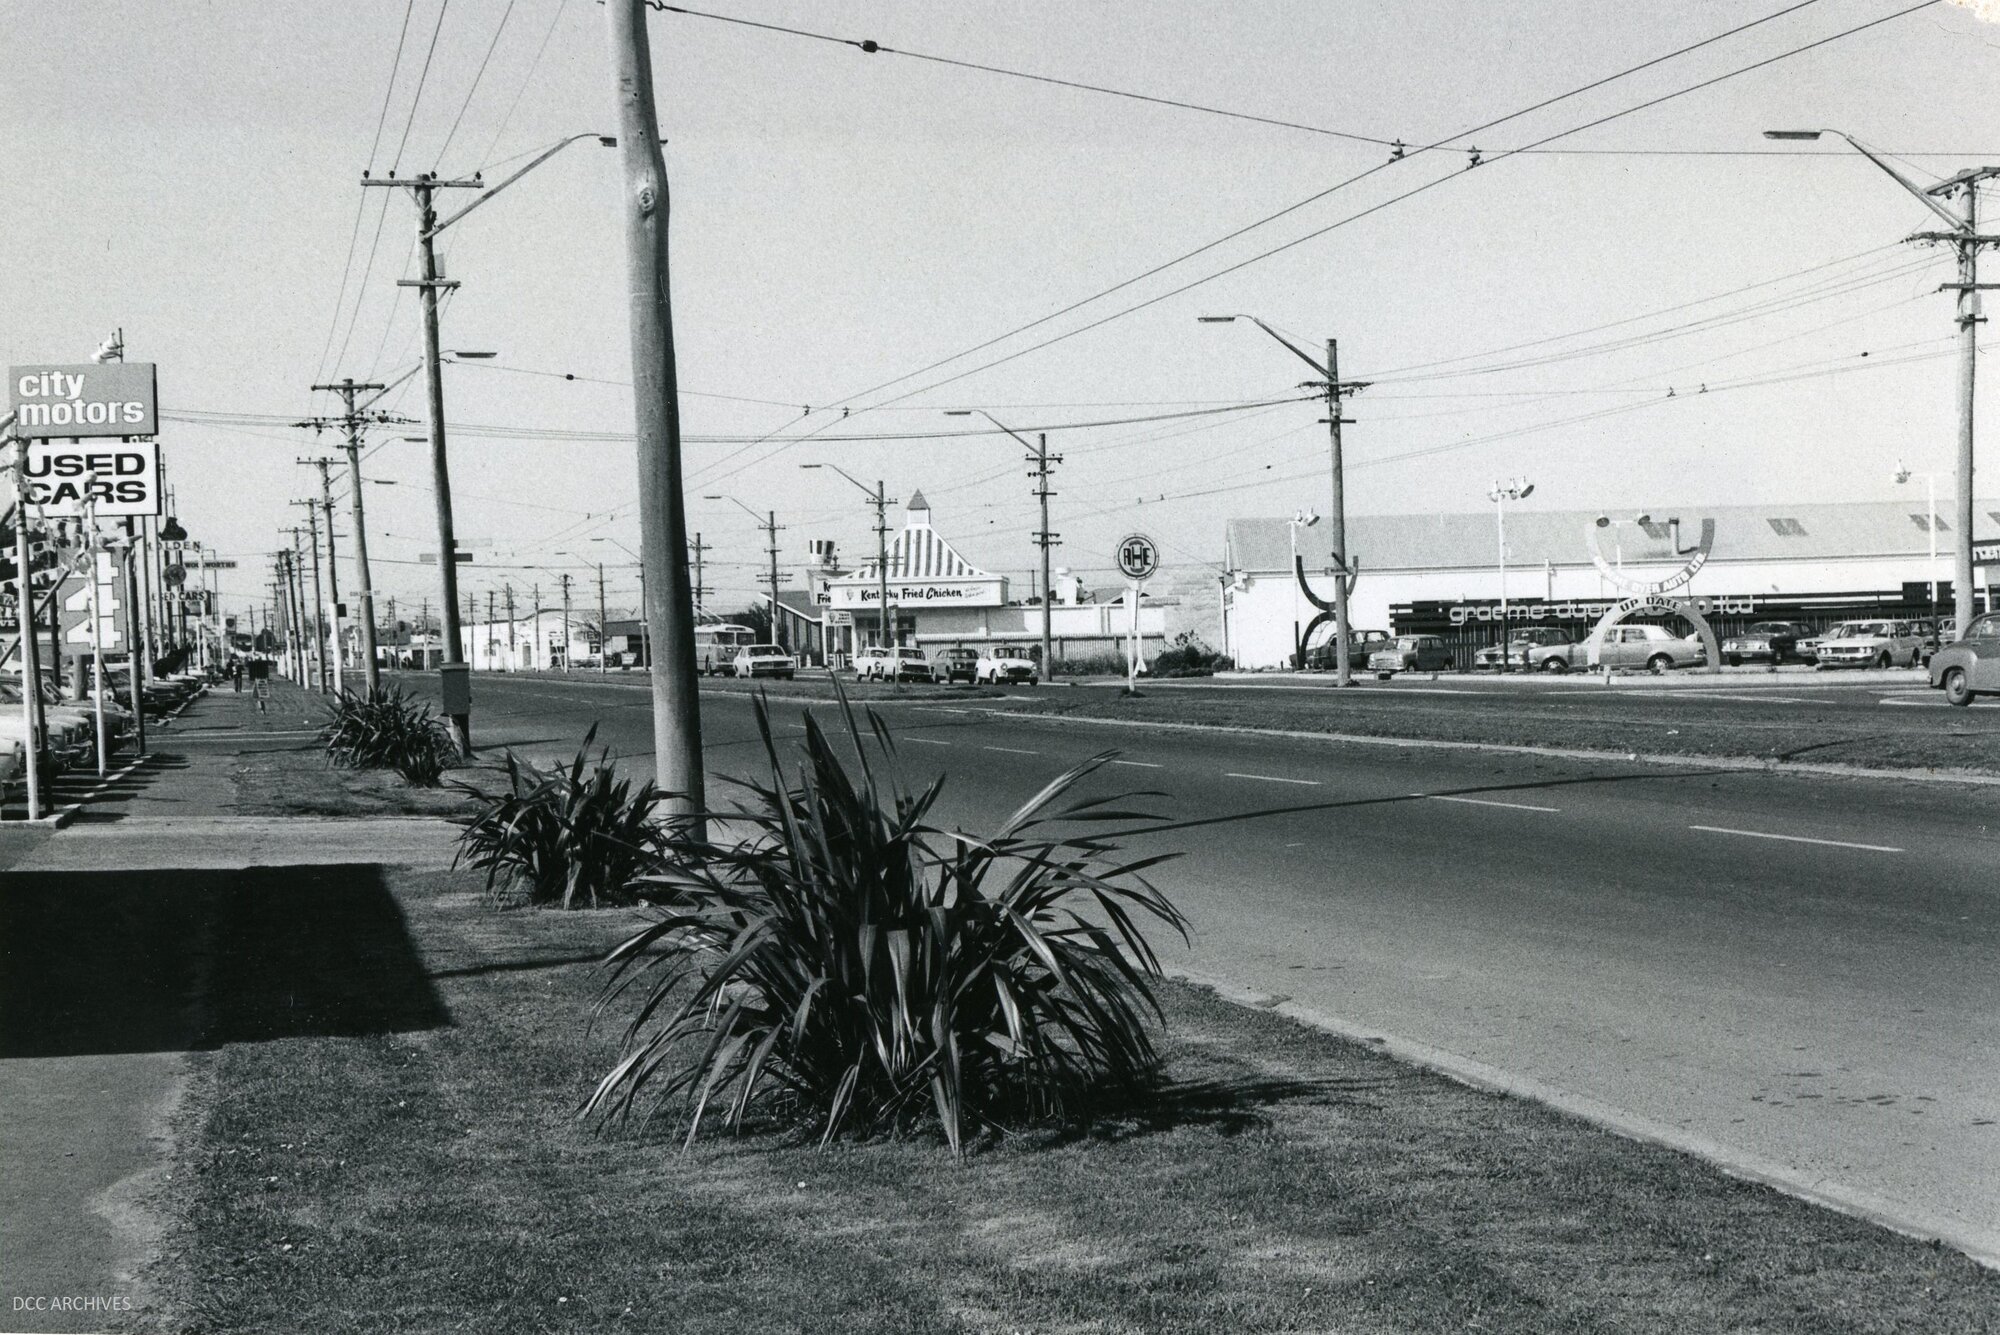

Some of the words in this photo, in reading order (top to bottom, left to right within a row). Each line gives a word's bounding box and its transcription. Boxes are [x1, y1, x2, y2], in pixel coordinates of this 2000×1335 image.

[18, 370, 85, 400] city
[19, 399, 145, 426] motors
[22, 453, 146, 477] USED
[23, 480, 147, 505] CARS
[1663, 570, 1691, 592] AUTO
[178, 591, 205, 601] CARS
[817, 593, 831, 605] Frie
[861, 589, 898, 601] Kentcky
[902, 588, 924, 600] Fried
[926, 587, 962, 600] Chicken
[1619, 598, 1639, 612] UP
[1646, 596, 1682, 611] DATE
[1450, 604, 1545, 626] graeme
[1720, 595, 1754, 615] ltd
